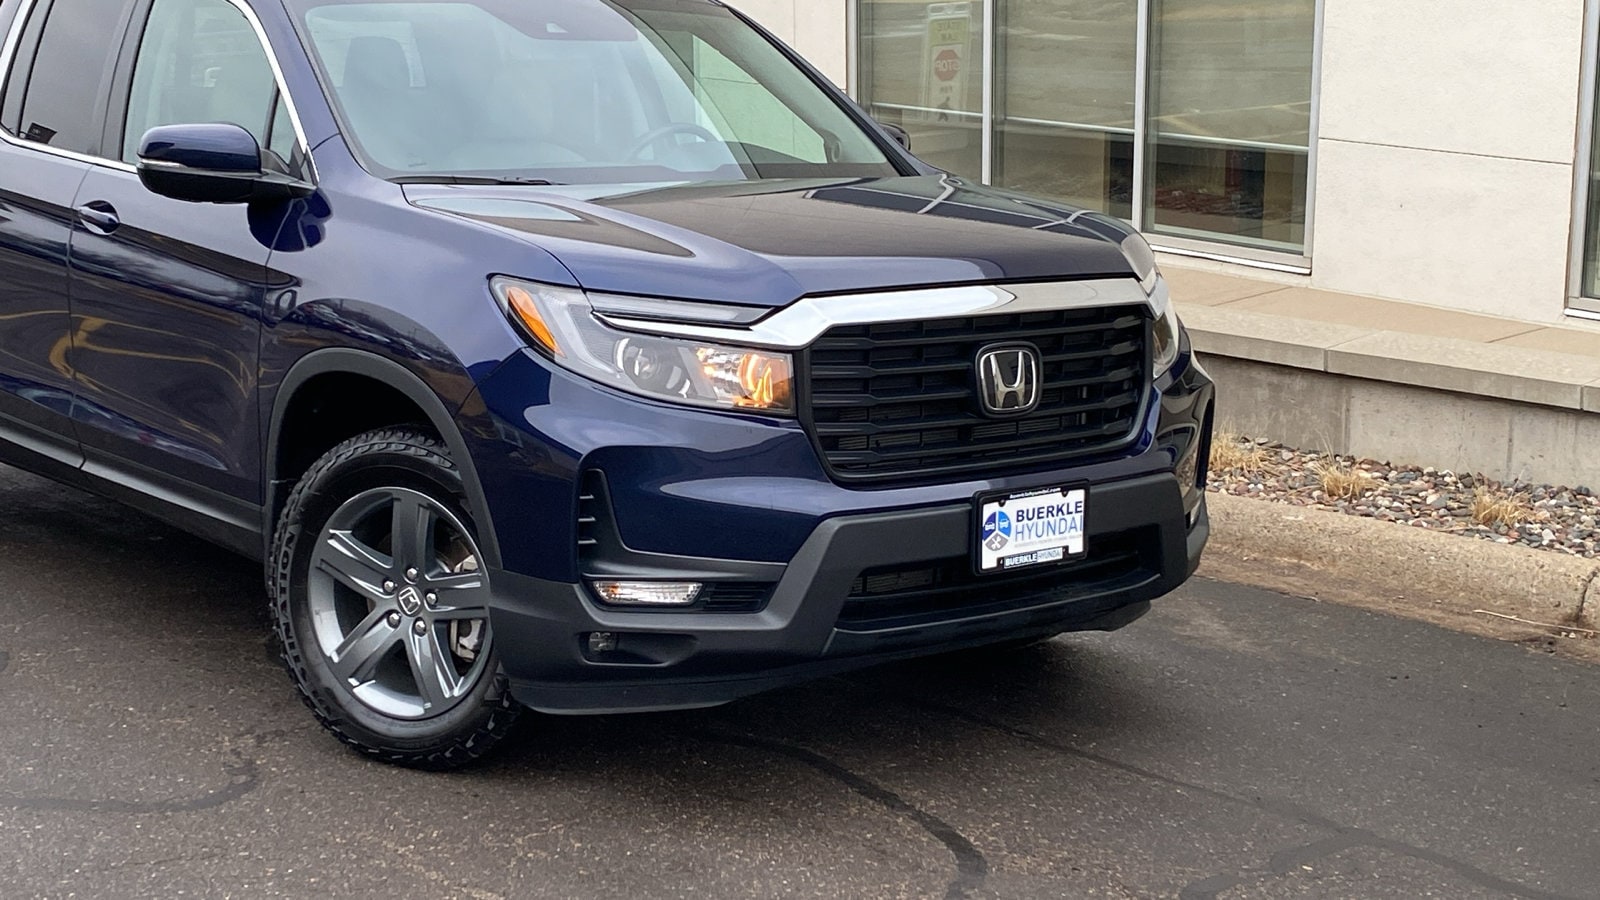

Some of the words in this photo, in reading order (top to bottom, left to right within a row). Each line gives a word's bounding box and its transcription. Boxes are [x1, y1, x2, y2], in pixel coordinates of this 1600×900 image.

[1016, 501, 1083, 523] BUERKLE
[1015, 515, 1083, 542] HYUNDAI
[1005, 553, 1037, 567] BUERKLE
[1038, 549, 1061, 562] HYUNDAI
